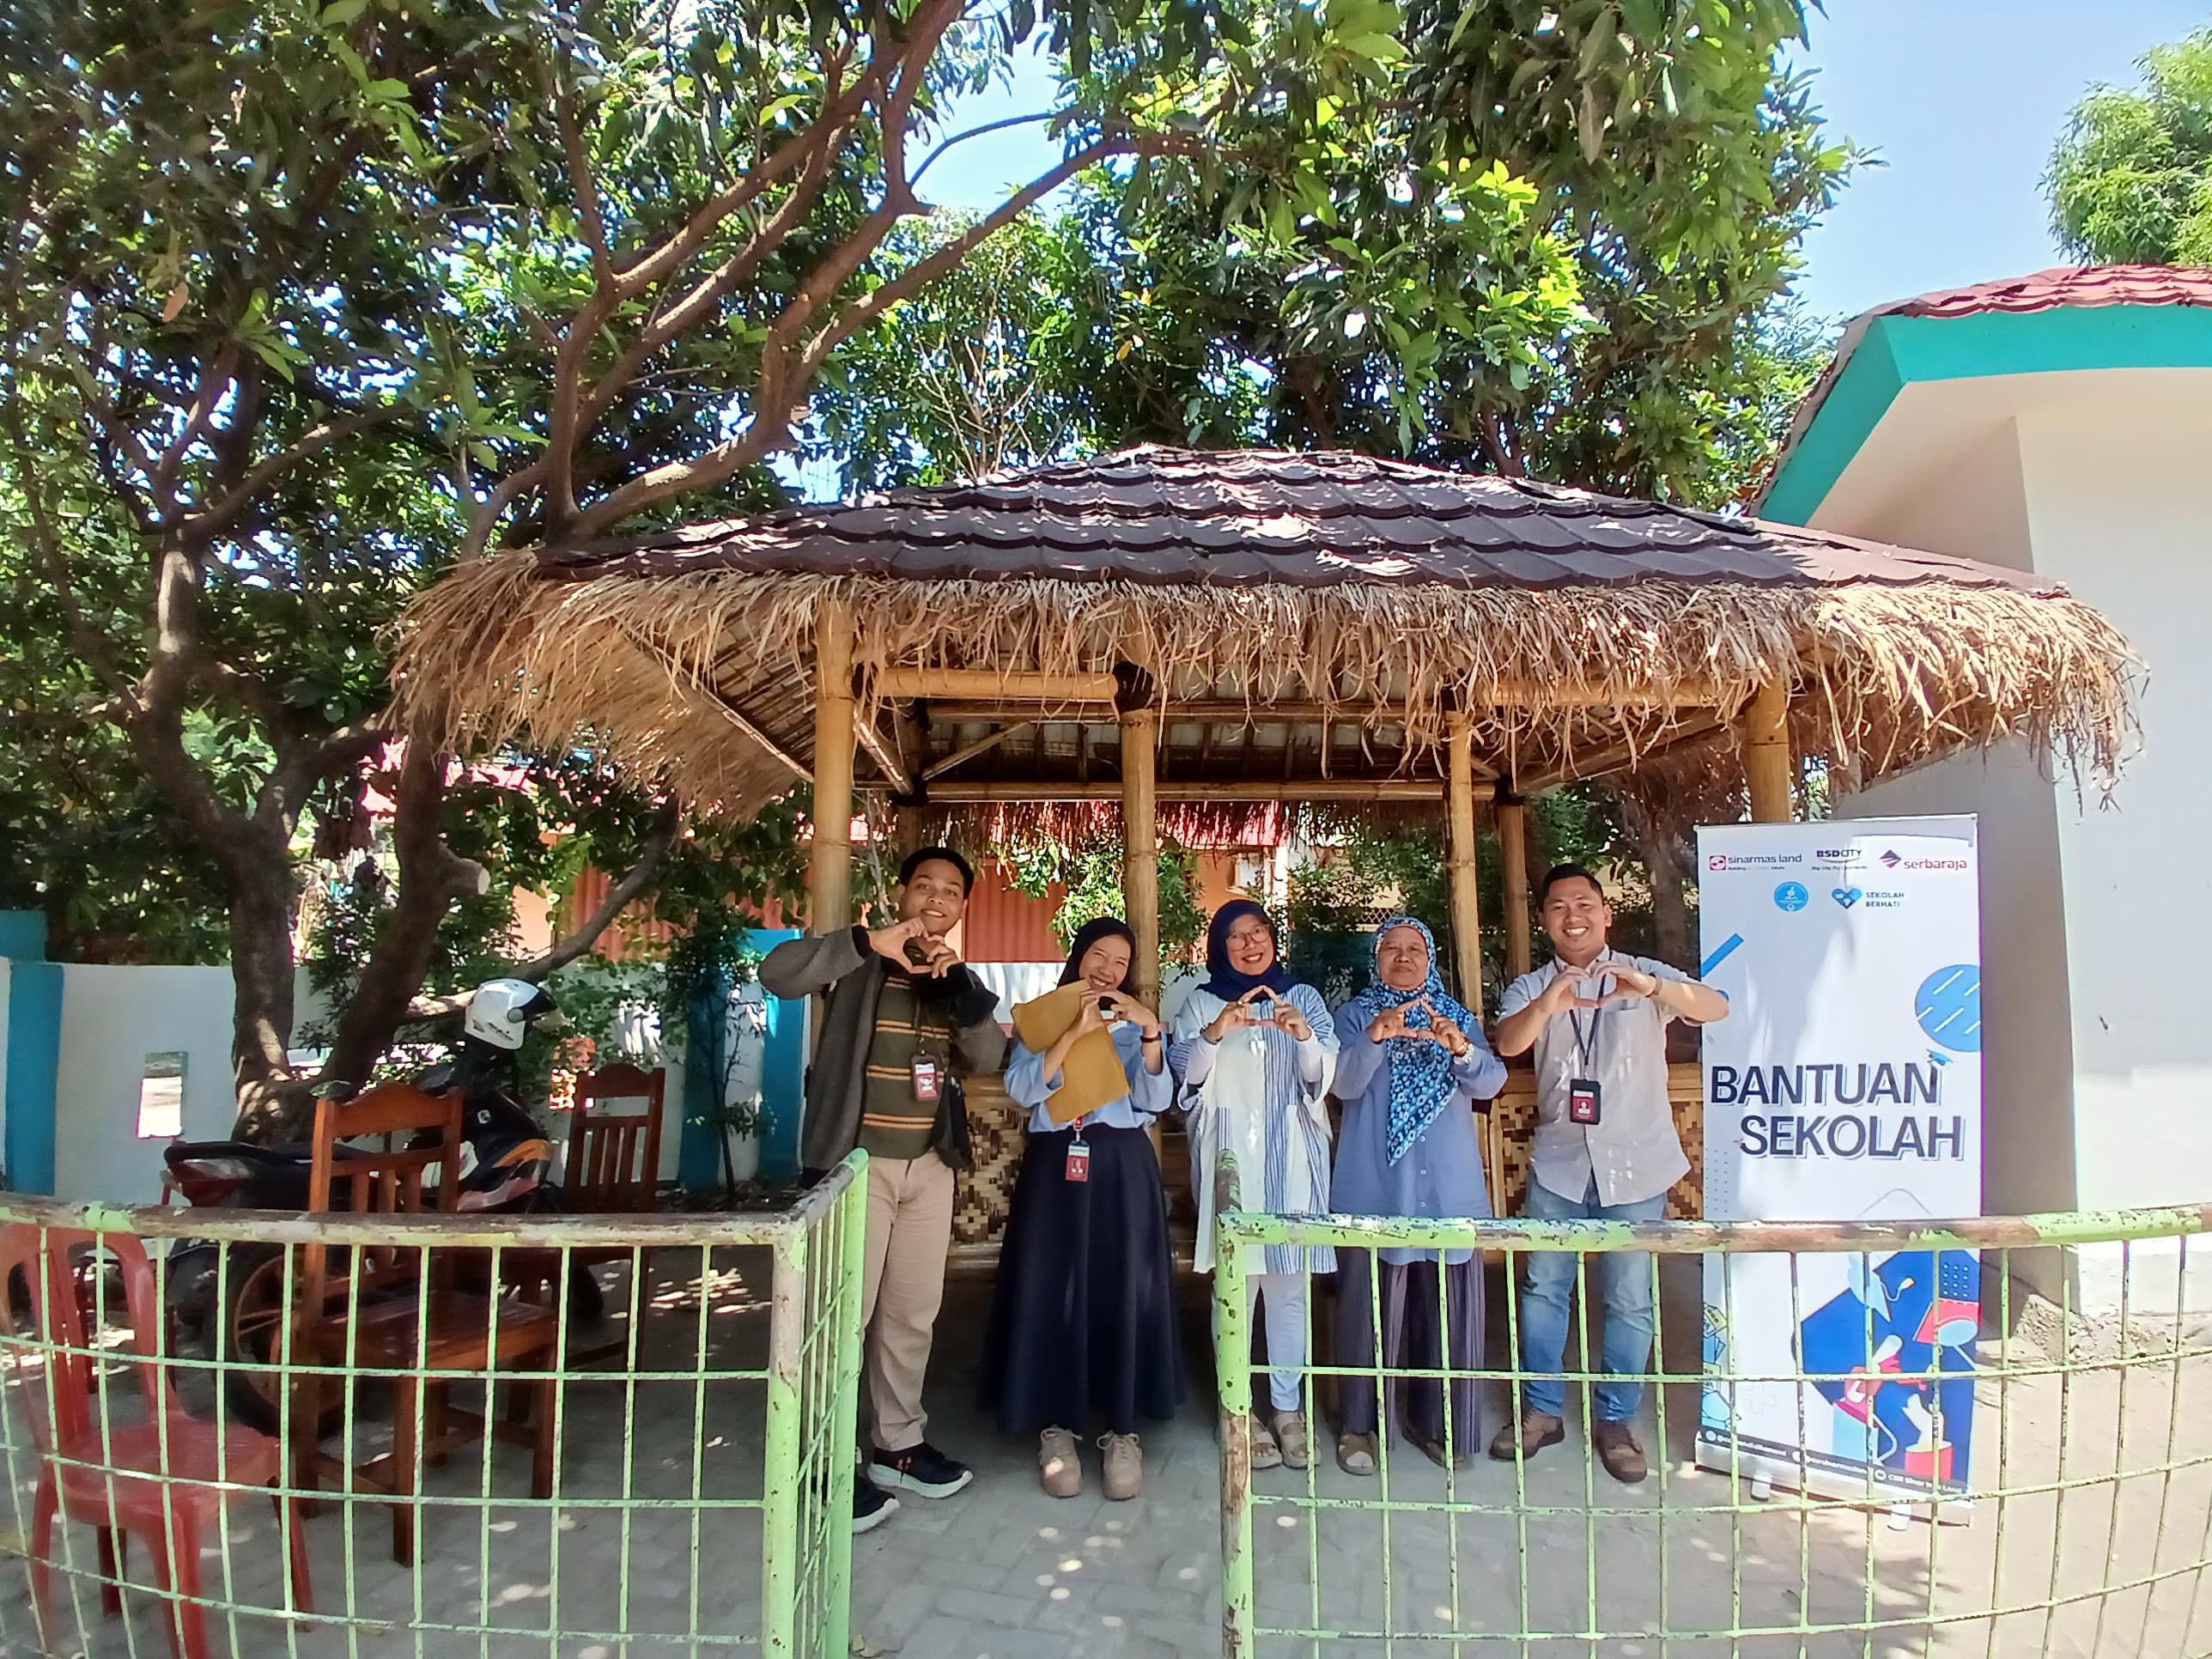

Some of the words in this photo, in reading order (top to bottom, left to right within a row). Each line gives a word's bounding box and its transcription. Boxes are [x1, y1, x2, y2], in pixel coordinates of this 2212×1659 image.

[1728, 855, 1777, 864] sinarmas
[1778, 854, 1802, 863] land
[1904, 859, 1967, 871] serbaraja
[1711, 1062, 1940, 1105] BANTUAN
[1739, 1115, 1962, 1159] SEKOLAH
